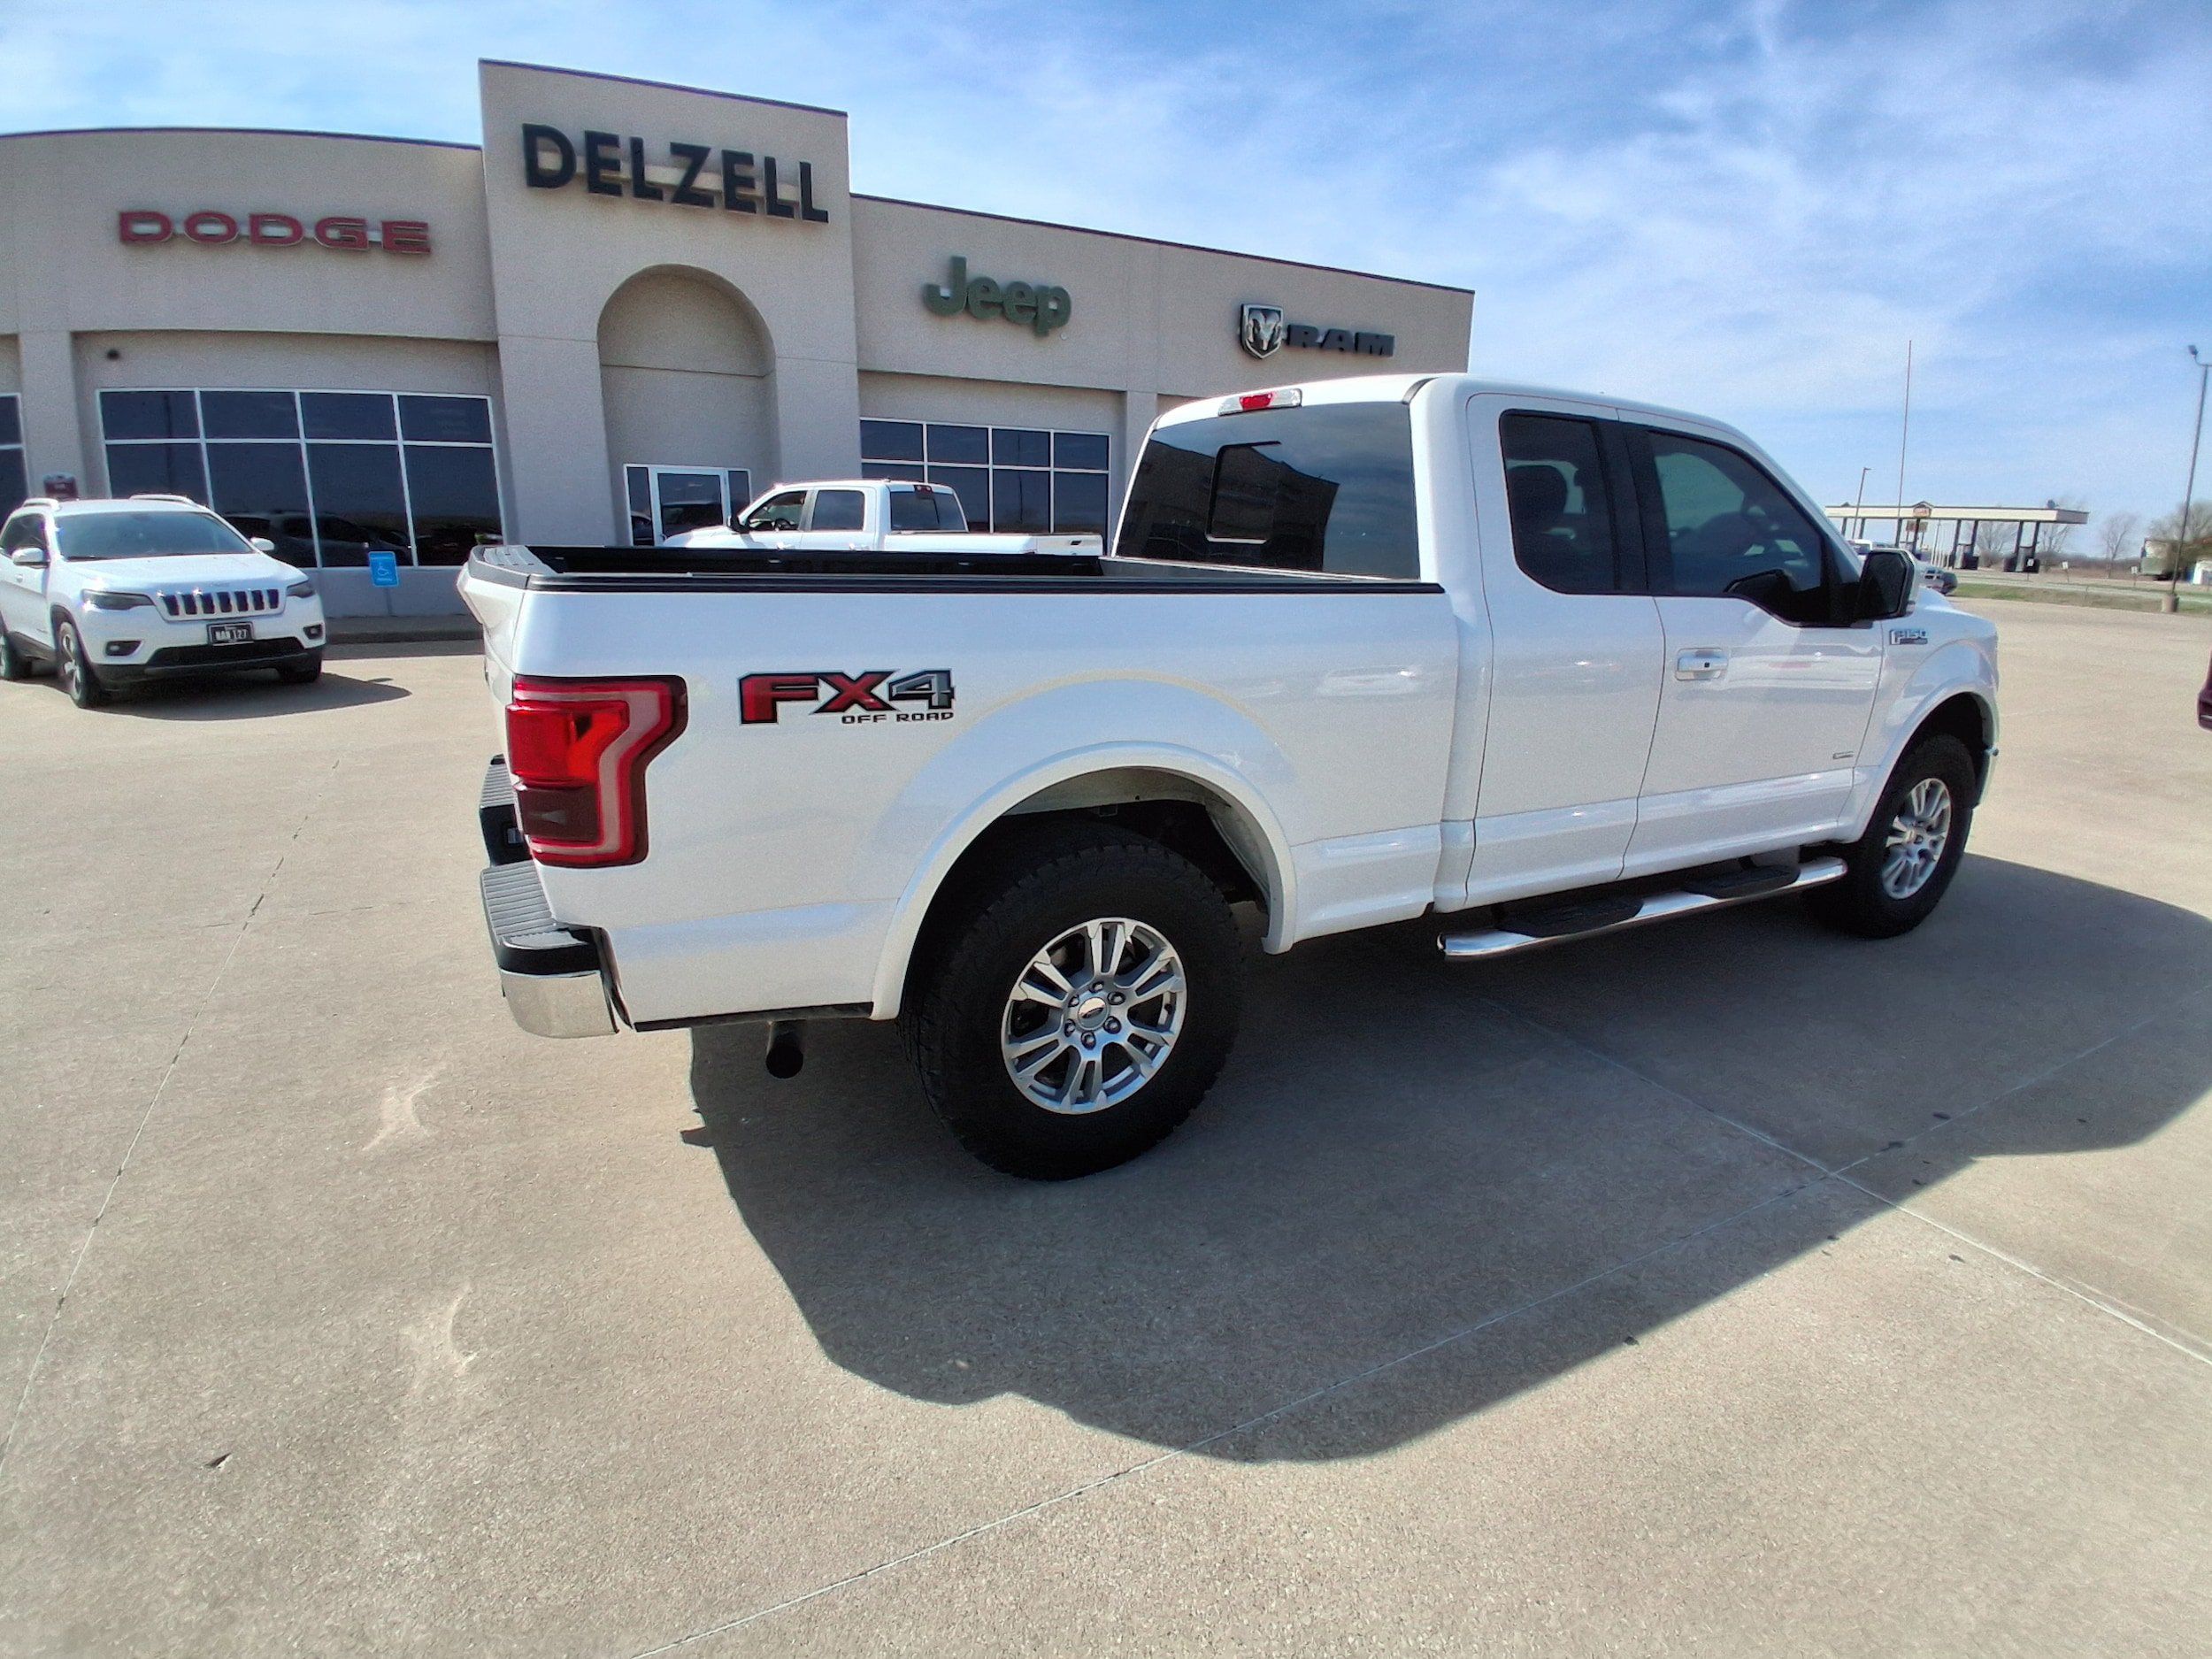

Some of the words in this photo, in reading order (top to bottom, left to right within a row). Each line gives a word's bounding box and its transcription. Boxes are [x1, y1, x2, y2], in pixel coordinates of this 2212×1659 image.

[522, 123, 829, 223] DELZELL
[119, 211, 432, 254] DODGE
[923, 256, 1071, 337] Jeep
[1286, 324, 1395, 357] RAM
[739, 669, 955, 725] FX4
[841, 714, 887, 725] OFF
[896, 711, 955, 723] ROAD
